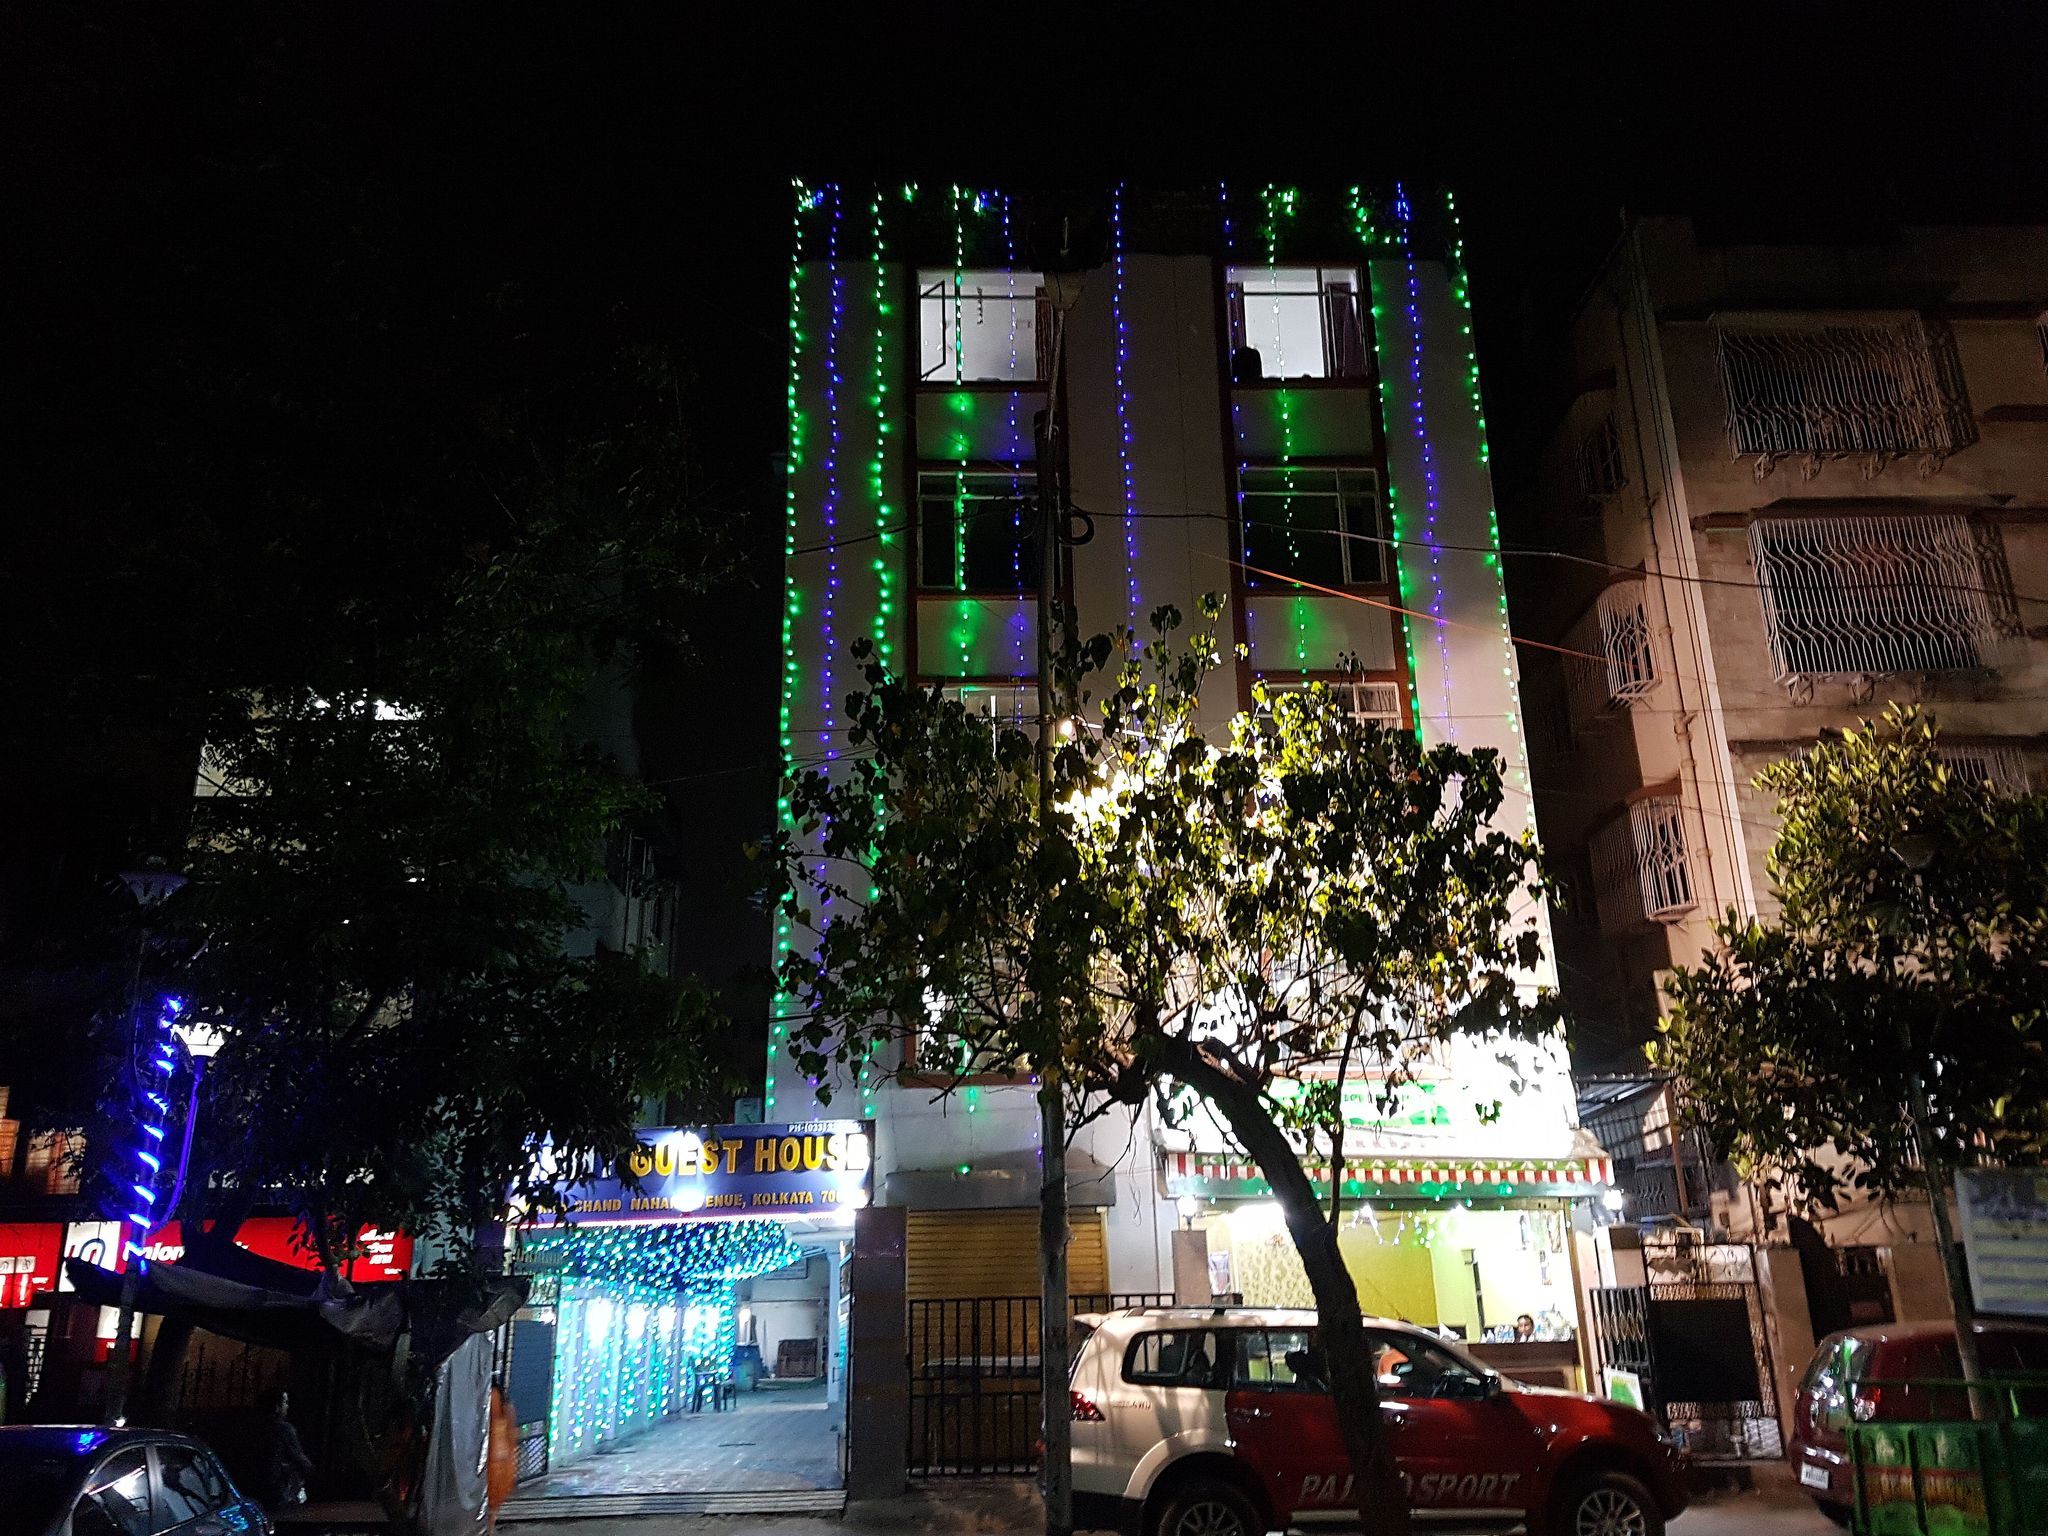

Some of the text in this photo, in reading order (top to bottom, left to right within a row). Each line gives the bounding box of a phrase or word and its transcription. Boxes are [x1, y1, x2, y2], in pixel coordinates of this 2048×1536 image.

[630, 1137, 743, 1177] GUEST
[575, 1199, 622, 1212] CHAND
[692, 1193, 745, 1209] ENUE,
[753, 1192, 813, 1205] KOLKATA
[1300, 1474, 1520, 1500] PAJ SPORT
